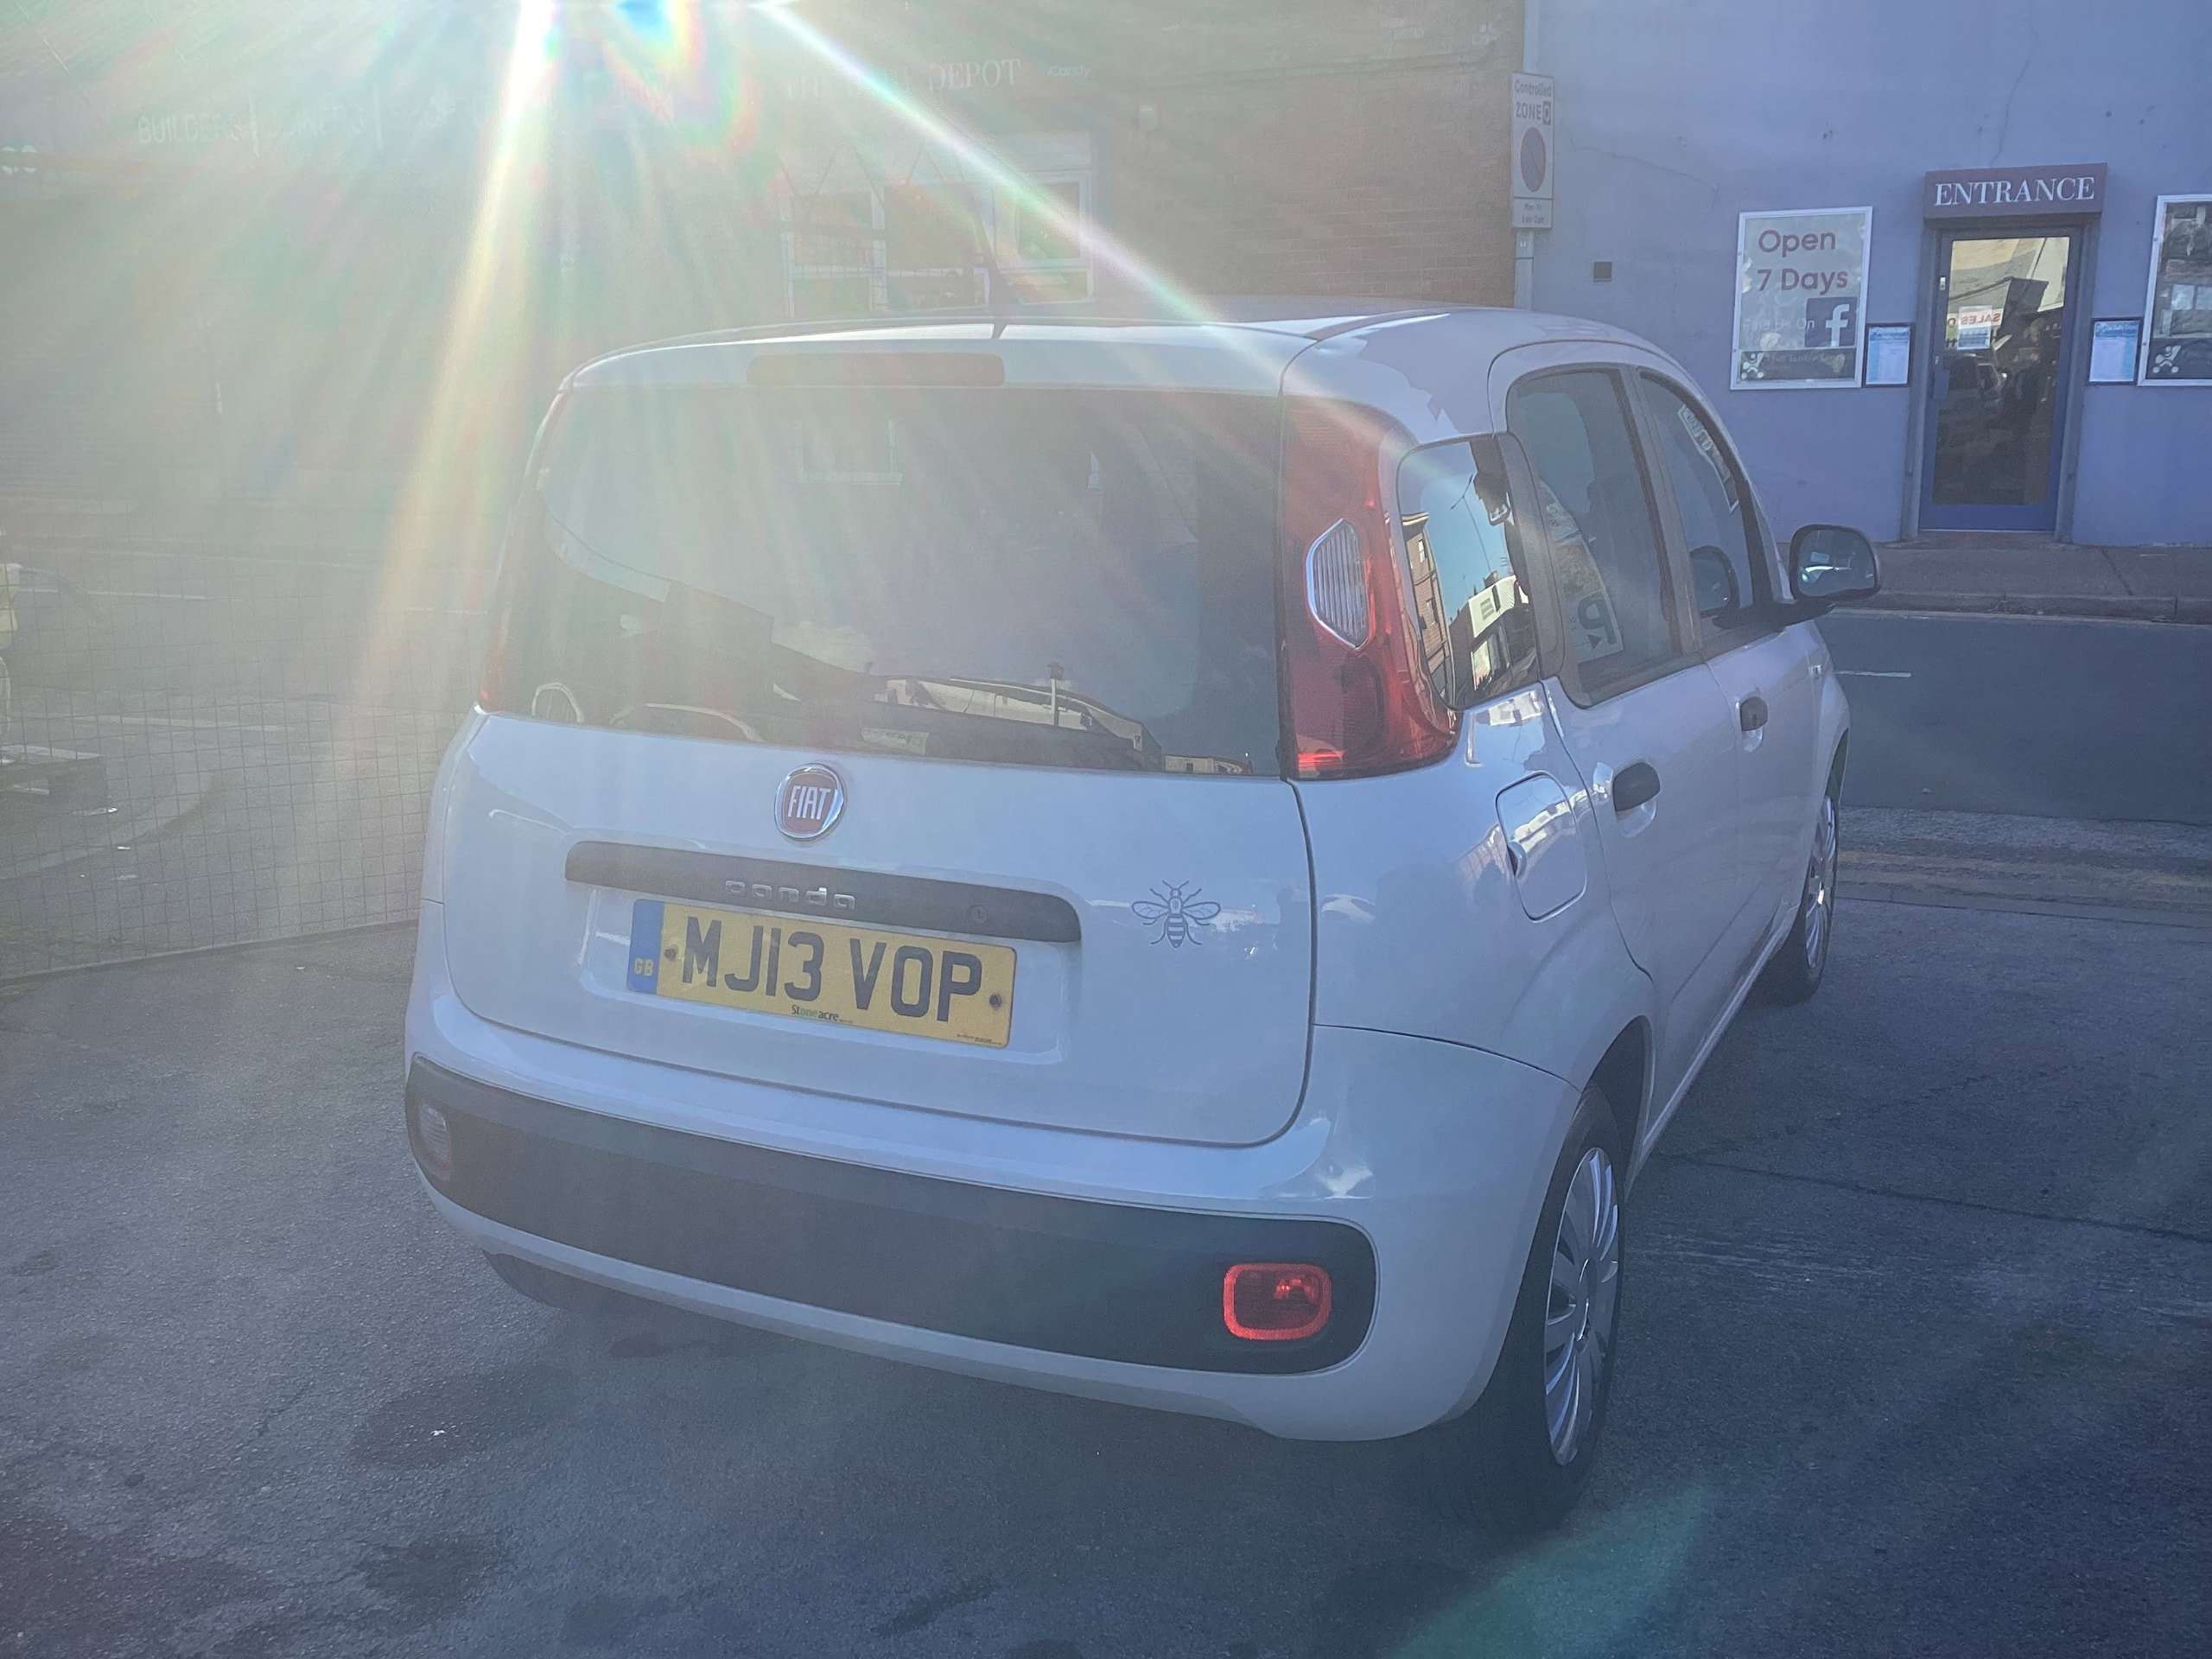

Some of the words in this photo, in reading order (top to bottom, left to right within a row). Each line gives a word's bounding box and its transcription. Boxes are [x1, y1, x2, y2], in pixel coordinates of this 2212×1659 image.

[1514, 79, 1552, 98] Controlled
[1516, 101, 1542, 120] ZONE
[1933, 175, 2095, 207] ENTRANCE
[1758, 228, 1837, 258] Open
[1757, 269, 1772, 292] 7
[1780, 267, 1849, 296] Days
[787, 785, 832, 821] FIAT
[681, 915, 826, 1003] MJ13
[849, 937, 983, 1024] VOP
[790, 1003, 841, 1023] Stoneacre
